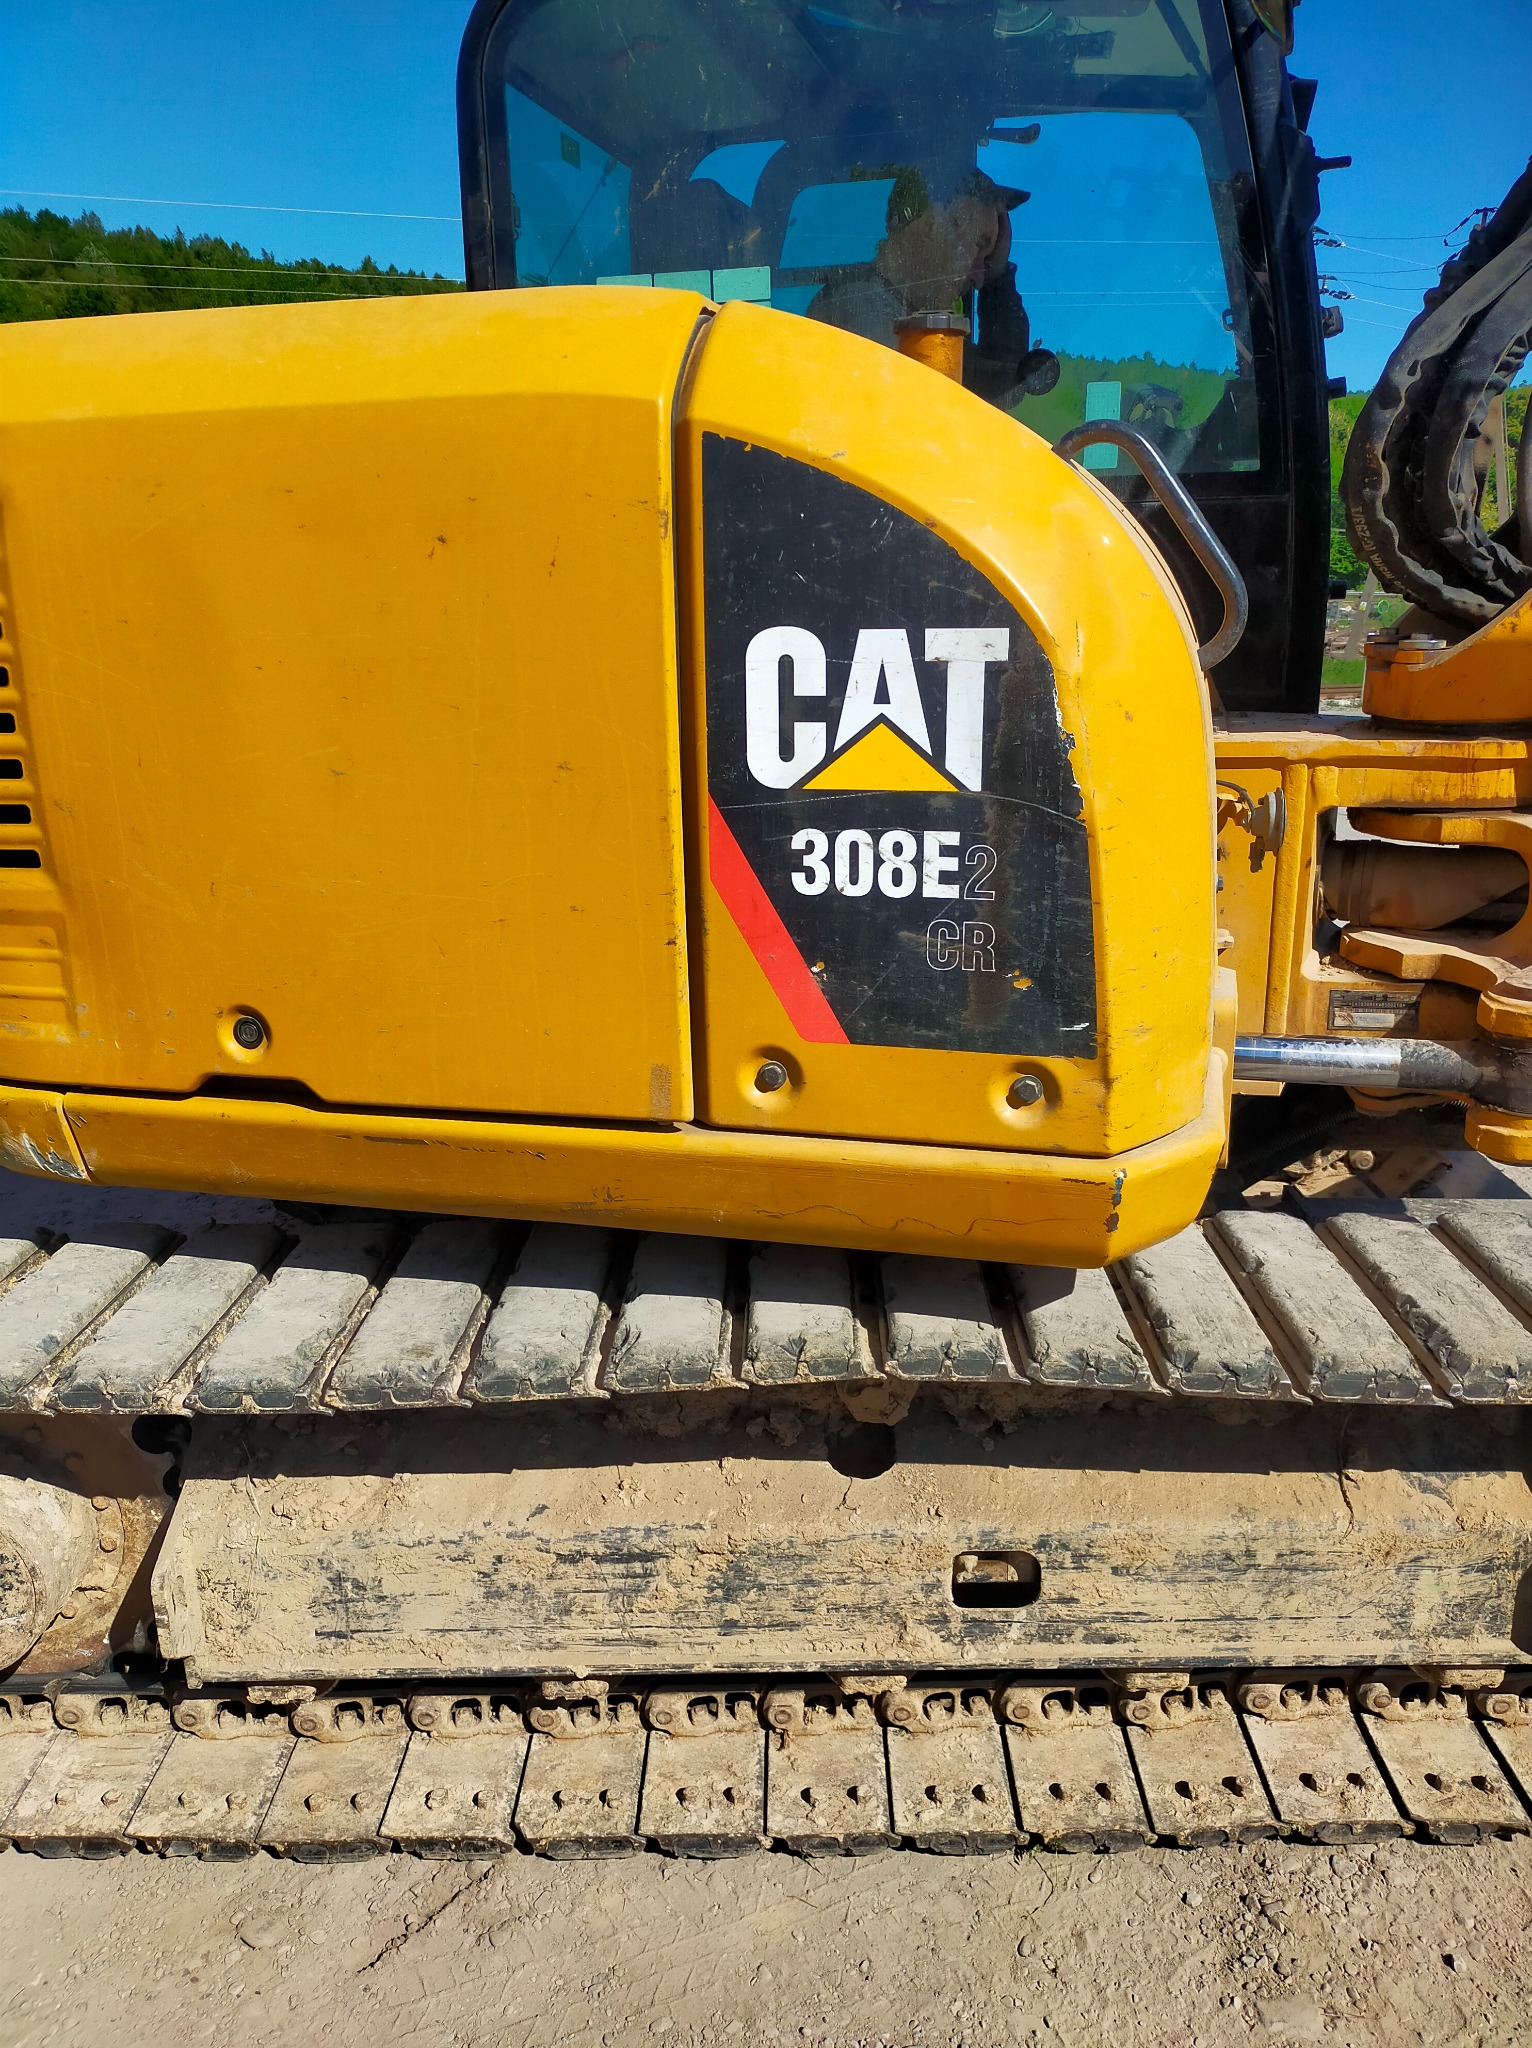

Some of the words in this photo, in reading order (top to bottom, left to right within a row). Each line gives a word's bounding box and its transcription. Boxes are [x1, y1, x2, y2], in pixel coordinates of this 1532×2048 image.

[745, 625, 1010, 792] CAT
[790, 828, 997, 901] 308E2
[926, 918, 996, 972] CR
